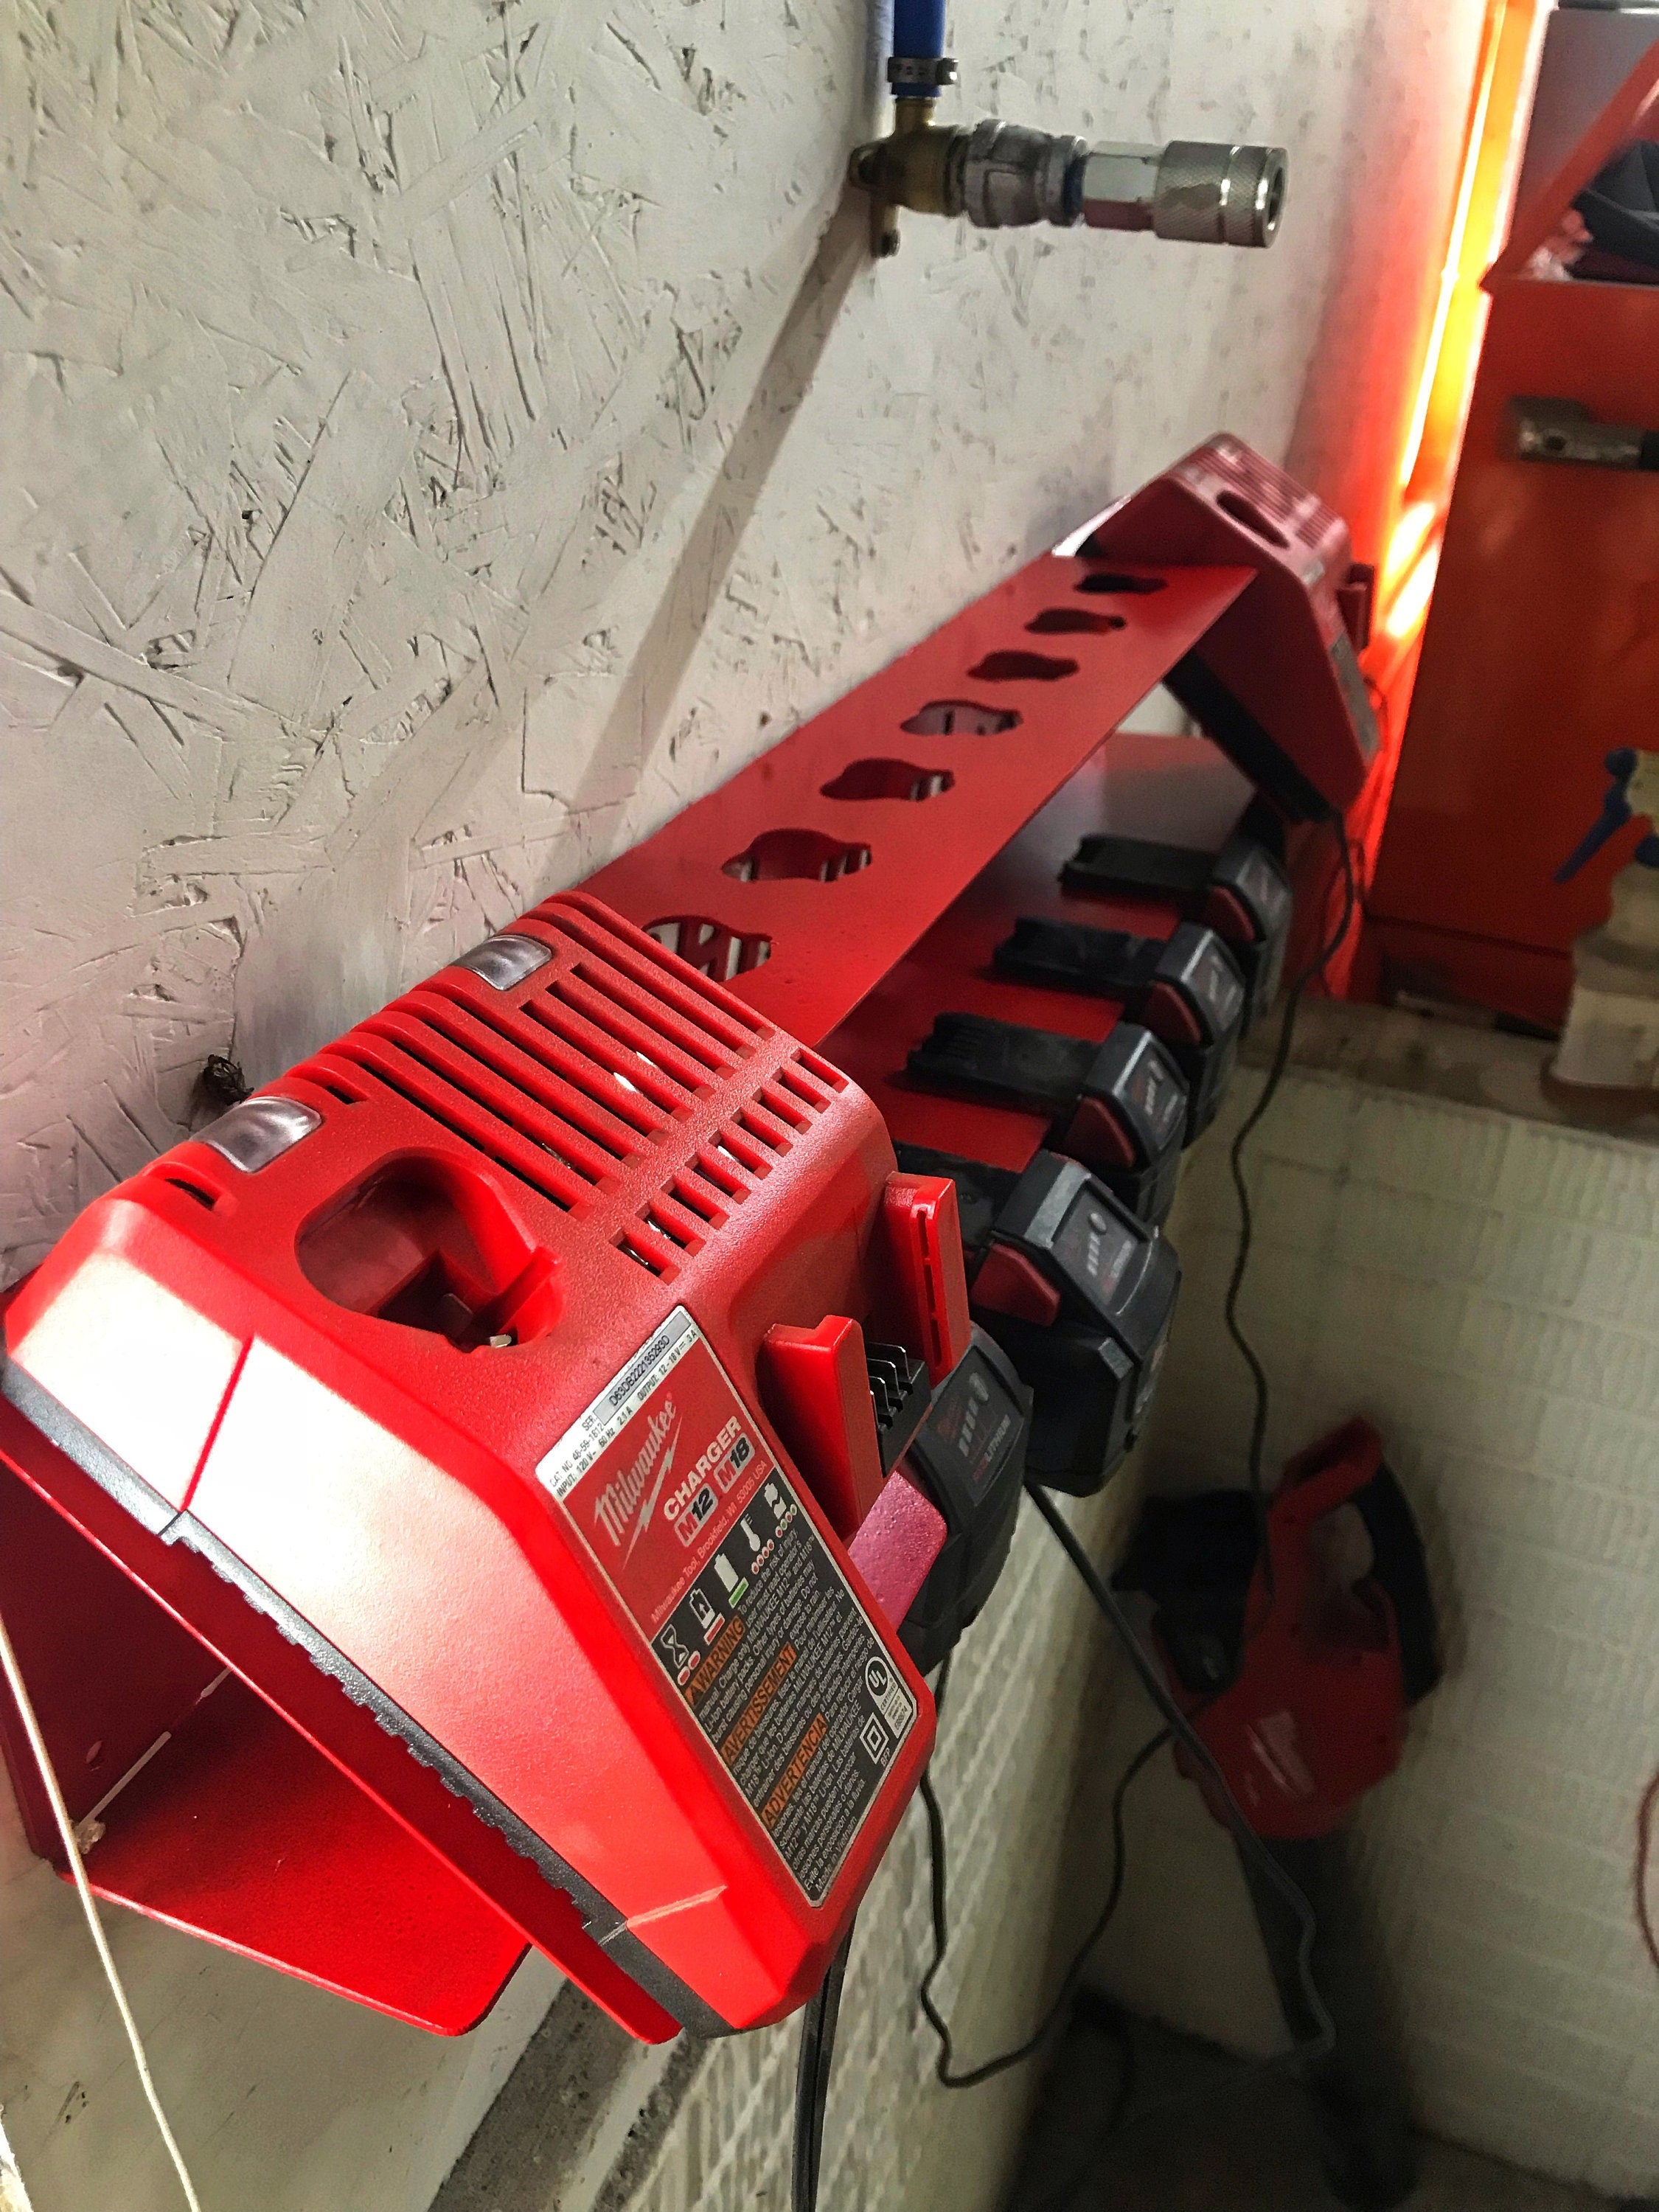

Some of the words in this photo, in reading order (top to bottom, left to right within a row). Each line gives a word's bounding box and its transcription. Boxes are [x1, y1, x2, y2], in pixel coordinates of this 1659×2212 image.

[571, 1421, 605, 1461] 48-59-1812
[576, 1455, 589, 1474] 120
[597, 1433, 608, 1447] 60
[605, 1425, 615, 1439] Hz
[625, 1405, 633, 1416] A
[686, 1332, 692, 1343] 3
[689, 1328, 696, 1338] A
[595, 1399, 675, 1546] Milwaukee
[661, 1414, 742, 1523] CHARGER
[675, 1485, 715, 1542] M12
[715, 1435, 753, 1488] M18
[650, 1573, 686, 1624] Milwaukee
[682, 1554, 700, 1580] Tool,
[696, 1512, 729, 1559] Brookfield,
[725, 1500, 737, 1517] WI
[735, 1475, 755, 1504] 53005
[751, 1458, 768, 1481] USA
[737, 1601, 748, 1617] To
[743, 1576, 764, 1607] reduce
[760, 1565, 771, 1582] the
[768, 1552, 780, 1571] risk
[776, 1543, 785, 1557] of
[782, 1526, 799, 1551] injury,
[744, 1607, 759, 1629] user
[755, 1588, 771, 1611] must
[766, 1571, 781, 1593] read
[777, 1538, 803, 1578] operator's
[694, 1616, 745, 1694] WARNING
[697, 1684, 721, 1722] manual.
[717, 1655, 741, 1691] Charge
[735, 1638, 751, 1663] only
[745, 1592, 779, 1644] MILWAUKEE
[790, 1555, 803, 1576] and
[711, 1717, 728, 1744] burst
[723, 1686, 748, 1725] causing
[742, 1654, 768, 1693] personal
[763, 1633, 781, 1661] injury
[776, 1625, 785, 1639] or
[782, 1595, 804, 1632] damage.
[799, 1582, 810, 1600] Do
[807, 1571, 818, 1588] not
[719, 1677, 741, 1711] battery
[736, 1652, 756, 1684] packs.
[751, 1630, 769, 1657] Other
[765, 1610, 782, 1638] types
[777, 1601, 787, 1615] of
[782, 1572, 805, 1607] batteries
[801, 1559, 815, 1580] may
[788, 1610, 808, 1642] expose
[804, 1601, 812, 1615] to
[793, 1628, 808, 1651] Pour
[804, 1595, 828, 1632] minimiser
[824, 1583, 835, 1600] les
[720, 1643, 796, 1764] AVERTISSEMENT
[731, 1745, 751, 1777] risque
[746, 1733, 757, 1750] de
[754, 1694, 781, 1739] blessures,
[776, 1676, 791, 1700] lisez
[787, 1668, 796, 1682] le
[806, 1635, 815, 1651] de
[834, 1586, 845, 1603] Ne
[738, 1750, 761, 1788] charger
[757, 1736, 771, 1756] que
[766, 1722, 777, 1739] les
[773, 1688, 797, 1727] batteries
[793, 1642, 824, 1694] MILWAUKEE
[834, 1610, 843, 1624] et
[772, 1751, 785, 1772] des
[804, 1705, 813, 1719] ou
[810, 1689, 821, 1708] des
[817, 1648, 845, 1694] dommages.
[841, 1613, 864, 1652] Gardez-le
[796, 1676, 818, 1713] marques
[813, 1663, 823, 1680] de
[819, 1633, 841, 1669] batteries
[824, 1699, 838, 1722] Para
[835, 1674, 852, 1704] reducir
[849, 1666, 856, 1678] el
[853, 1644, 869, 1672] riesgo
[865, 1634, 874, 1649] de
[868, 1669, 886, 1688] UL
[761, 1713, 828, 1827] ADVERTENCIA
[771, 1798, 796, 1840] lesiones,
[791, 1784, 803, 1803] lea
[799, 1775, 807, 1790] el
[804, 1746, 824, 1781] manual
[820, 1733, 831, 1752] del
[846, 1673, 865, 1705] Cargar
[801, 1790, 812, 1807] las
[826, 1747, 835, 1763] de
[831, 1699, 861, 1751] MILWAUKEE
[801, 1821, 808, 1834] y
[831, 1752, 844, 1773] Las
[855, 1711, 865, 1728] de
[846, 1796, 855, 1810] la
[880, 1746, 891, 1767] BFP
[790, 1843, 807, 1871] otras
[803, 1814, 823, 1848] marcas
[819, 1783, 840, 1820] pueden
[835, 1750, 858, 1790] provocar
[797, 1842, 820, 1882] lesiones
[815, 1798, 844, 1847] personales
[840, 1792, 846, 1803] o
[815, 1860, 832, 1893] Made
[829, 1850, 838, 1865] in
[835, 1813, 857, 1854] Vietnam
[815, 1854, 824, 1869] la
[844, 1806, 850, 1818] a
[804, 1863, 819, 1891] Evite
